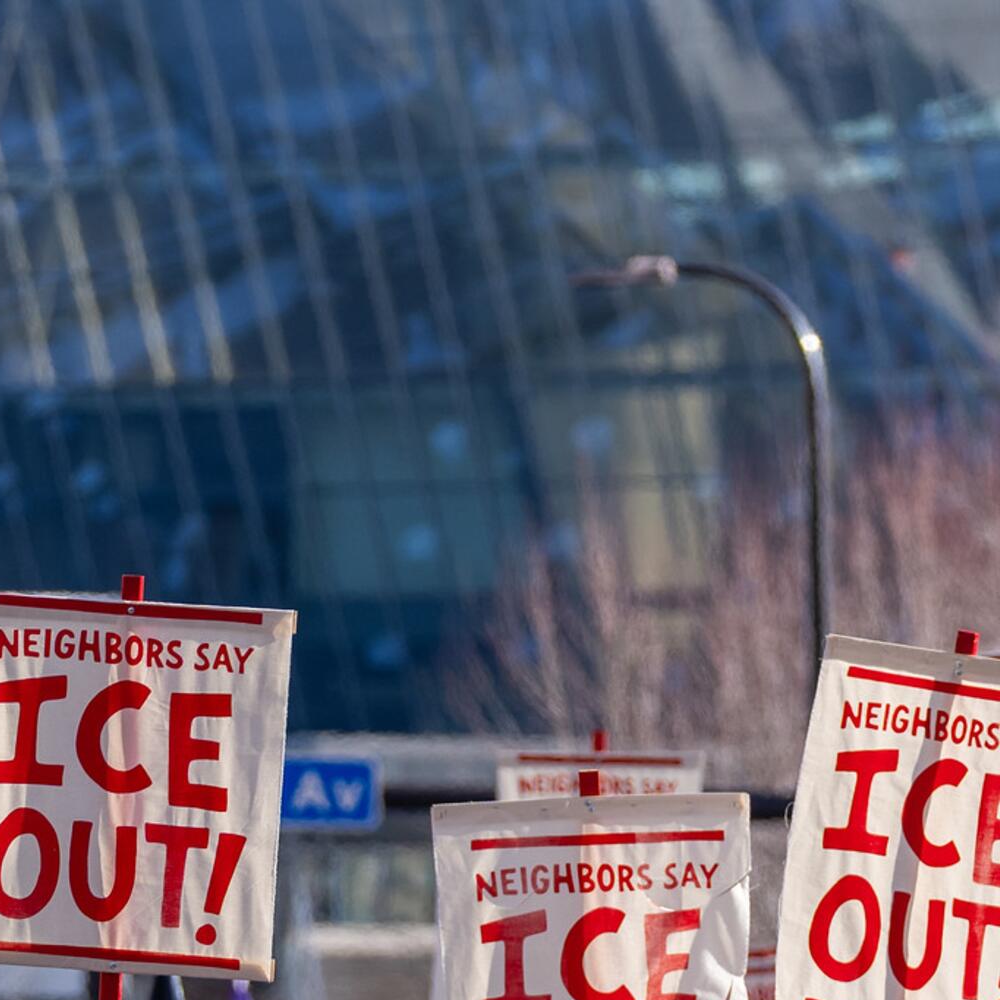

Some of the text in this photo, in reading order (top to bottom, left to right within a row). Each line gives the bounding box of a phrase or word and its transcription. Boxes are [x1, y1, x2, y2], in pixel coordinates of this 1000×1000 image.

[194, 643, 254, 674] SAY
[841, 700, 1000, 752] NEIGHBORS
[475, 862, 719, 902] NEIGHBORS SAY
